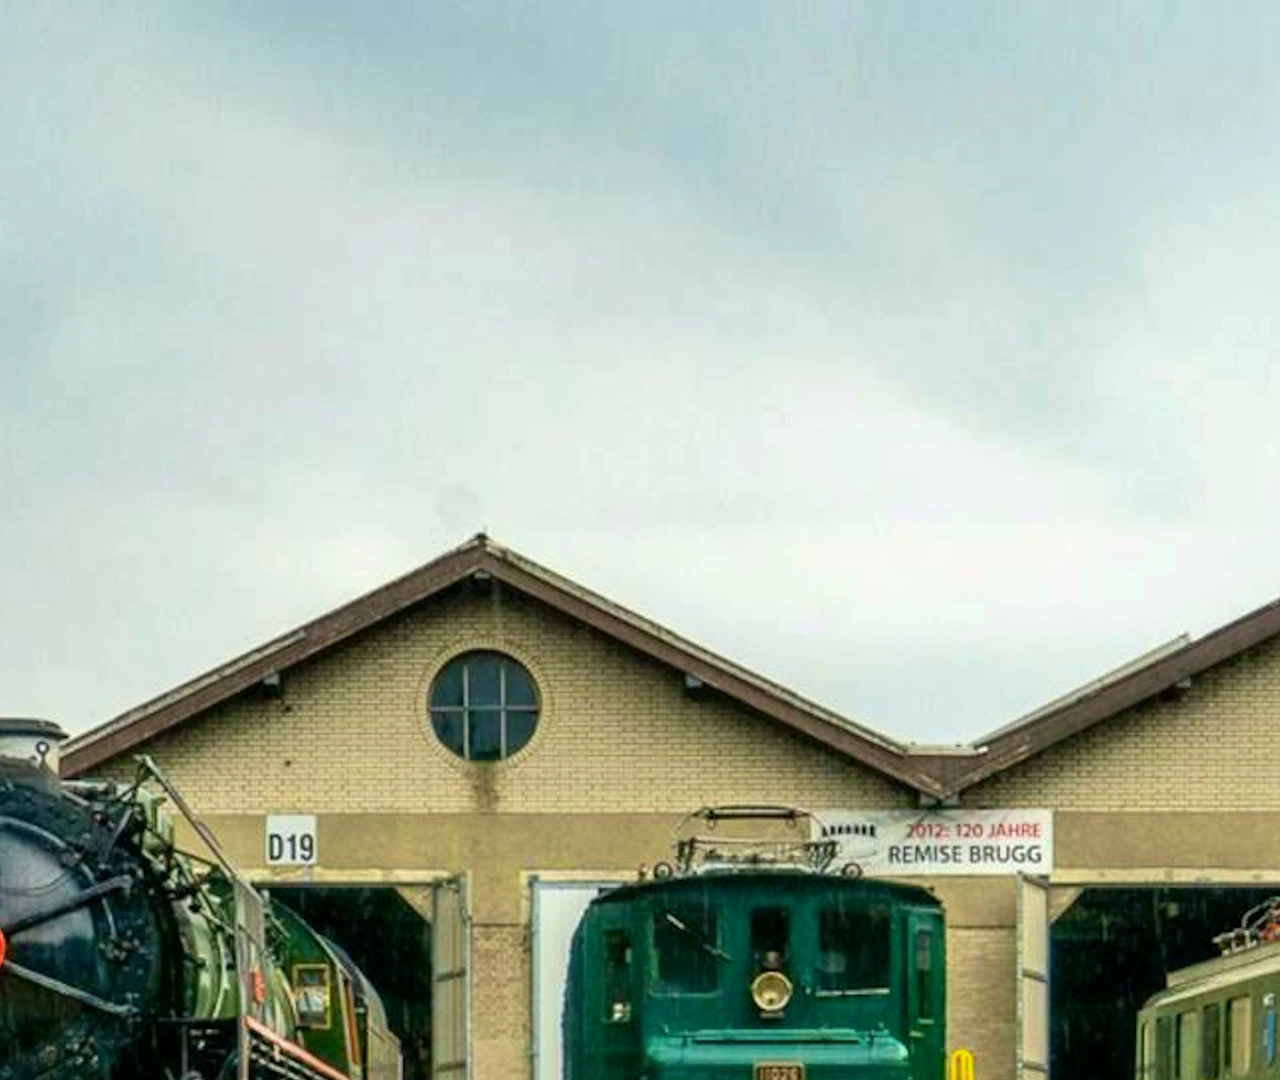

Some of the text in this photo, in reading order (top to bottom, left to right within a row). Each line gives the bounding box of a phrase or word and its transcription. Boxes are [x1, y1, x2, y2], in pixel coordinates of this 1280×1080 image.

[907, 823, 1041, 838] 2012: 120 JAHRE
[269, 833, 314, 862] D19
[888, 844, 1043, 864] REMISE BRUGG
